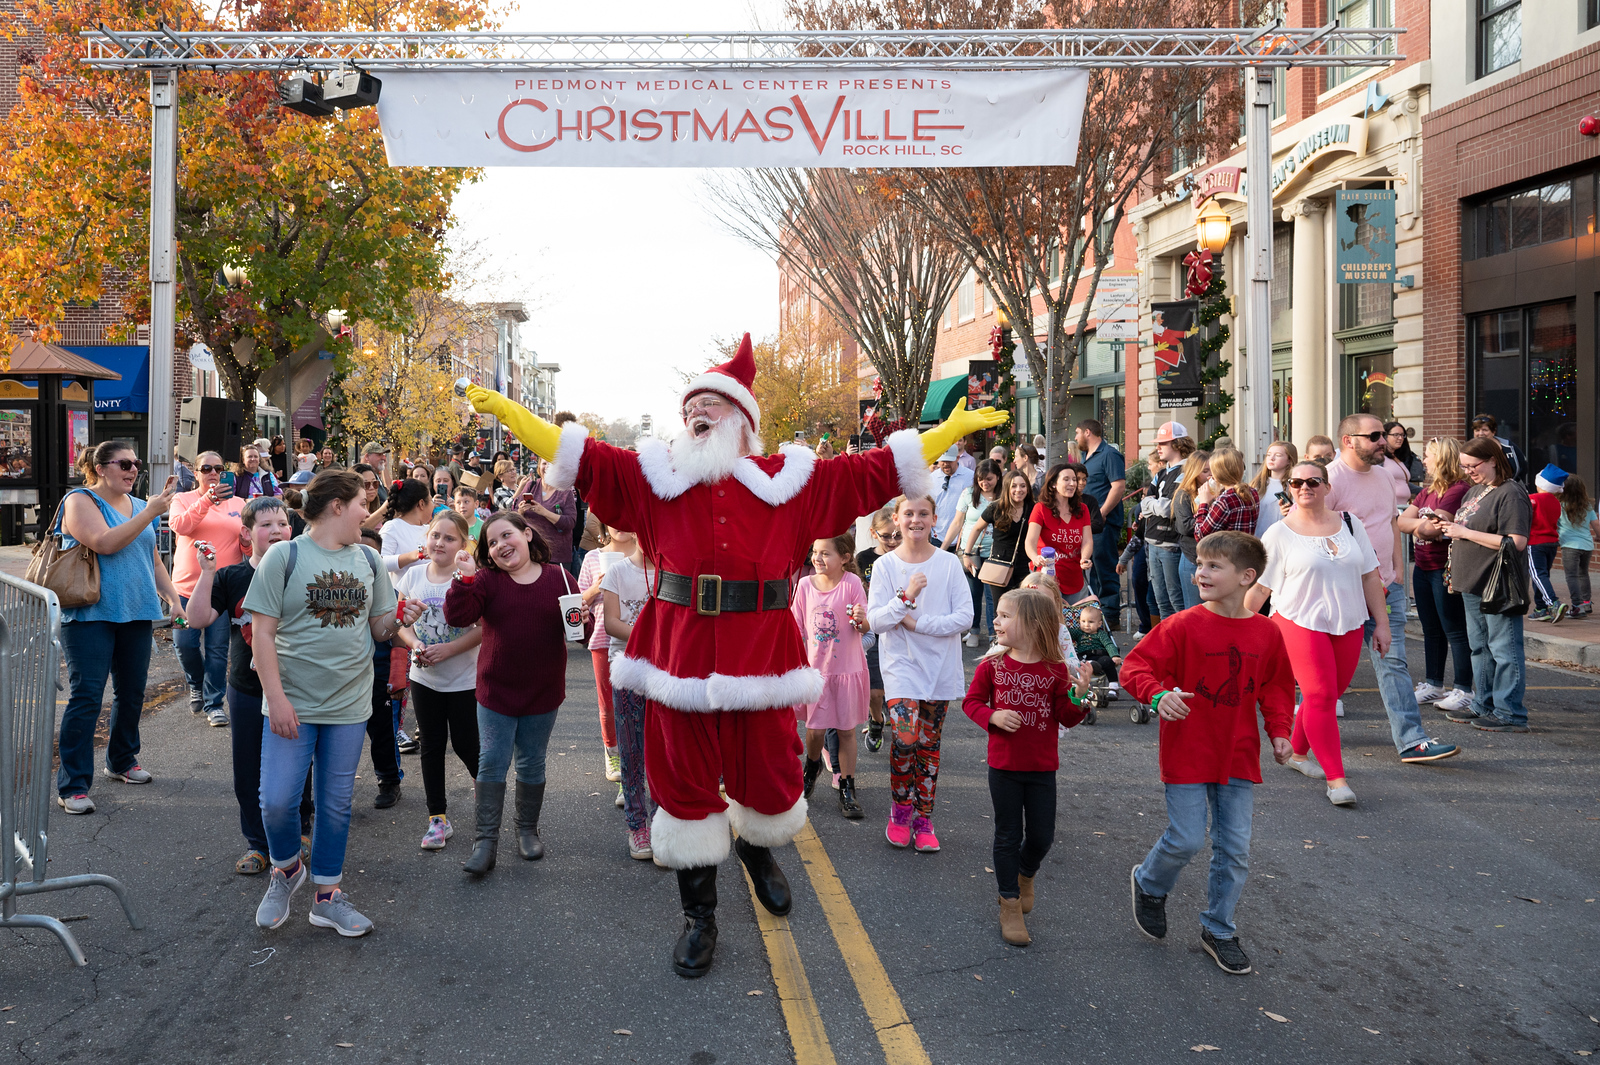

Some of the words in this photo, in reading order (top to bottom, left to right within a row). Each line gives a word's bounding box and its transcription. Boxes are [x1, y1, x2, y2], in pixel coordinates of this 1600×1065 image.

[515, 79, 627, 91] PIEDMONT
[636, 79, 733, 90] MEDICAL
[743, 79, 828, 90] CENTER
[839, 78, 951, 90] PRESENTS
[1298, 124, 1350, 164] MUSEUM
[843, 145, 889, 155] ROCK
[895, 145, 936, 157] HILL,
[940, 145, 962, 155] SC
[1364, 192, 1391, 200] STREET
[1341, 263, 1392, 271] CHILDREN'S
[1345, 271, 1387, 280] MUSEUM
[94, 399, 121, 408] UNTY
[994, 672, 1055, 690] SNOW
[995, 688, 1049, 708] MUCH
